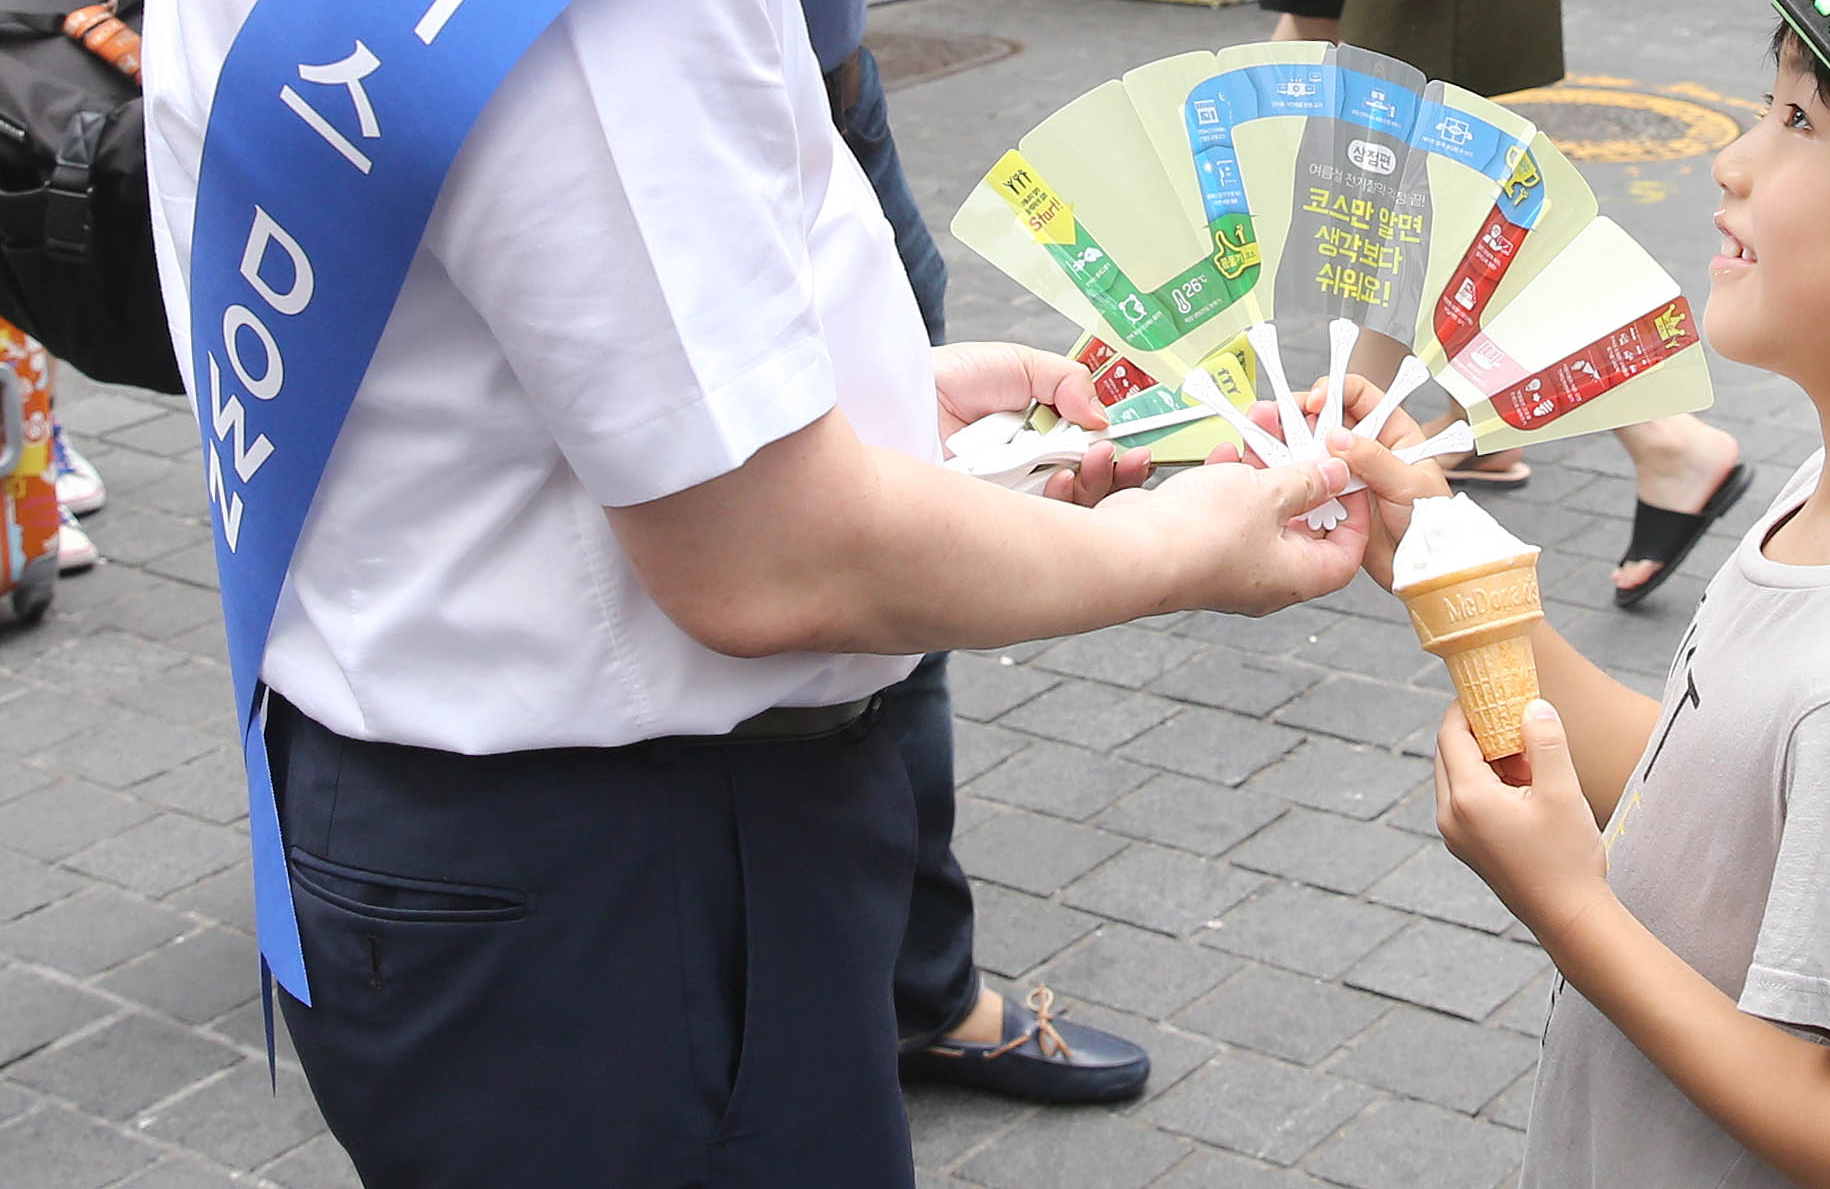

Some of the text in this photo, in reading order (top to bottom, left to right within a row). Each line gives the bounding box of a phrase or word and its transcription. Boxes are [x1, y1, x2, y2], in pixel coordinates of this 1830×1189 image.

[1352, 145, 1392, 172] 상점편
[1302, 186, 1424, 244] 코스만 알면
[1313, 224, 1404, 275] 생각보다
[1314, 262, 1392, 309] 쉬워요!
[207, 204, 316, 555] DOWN
